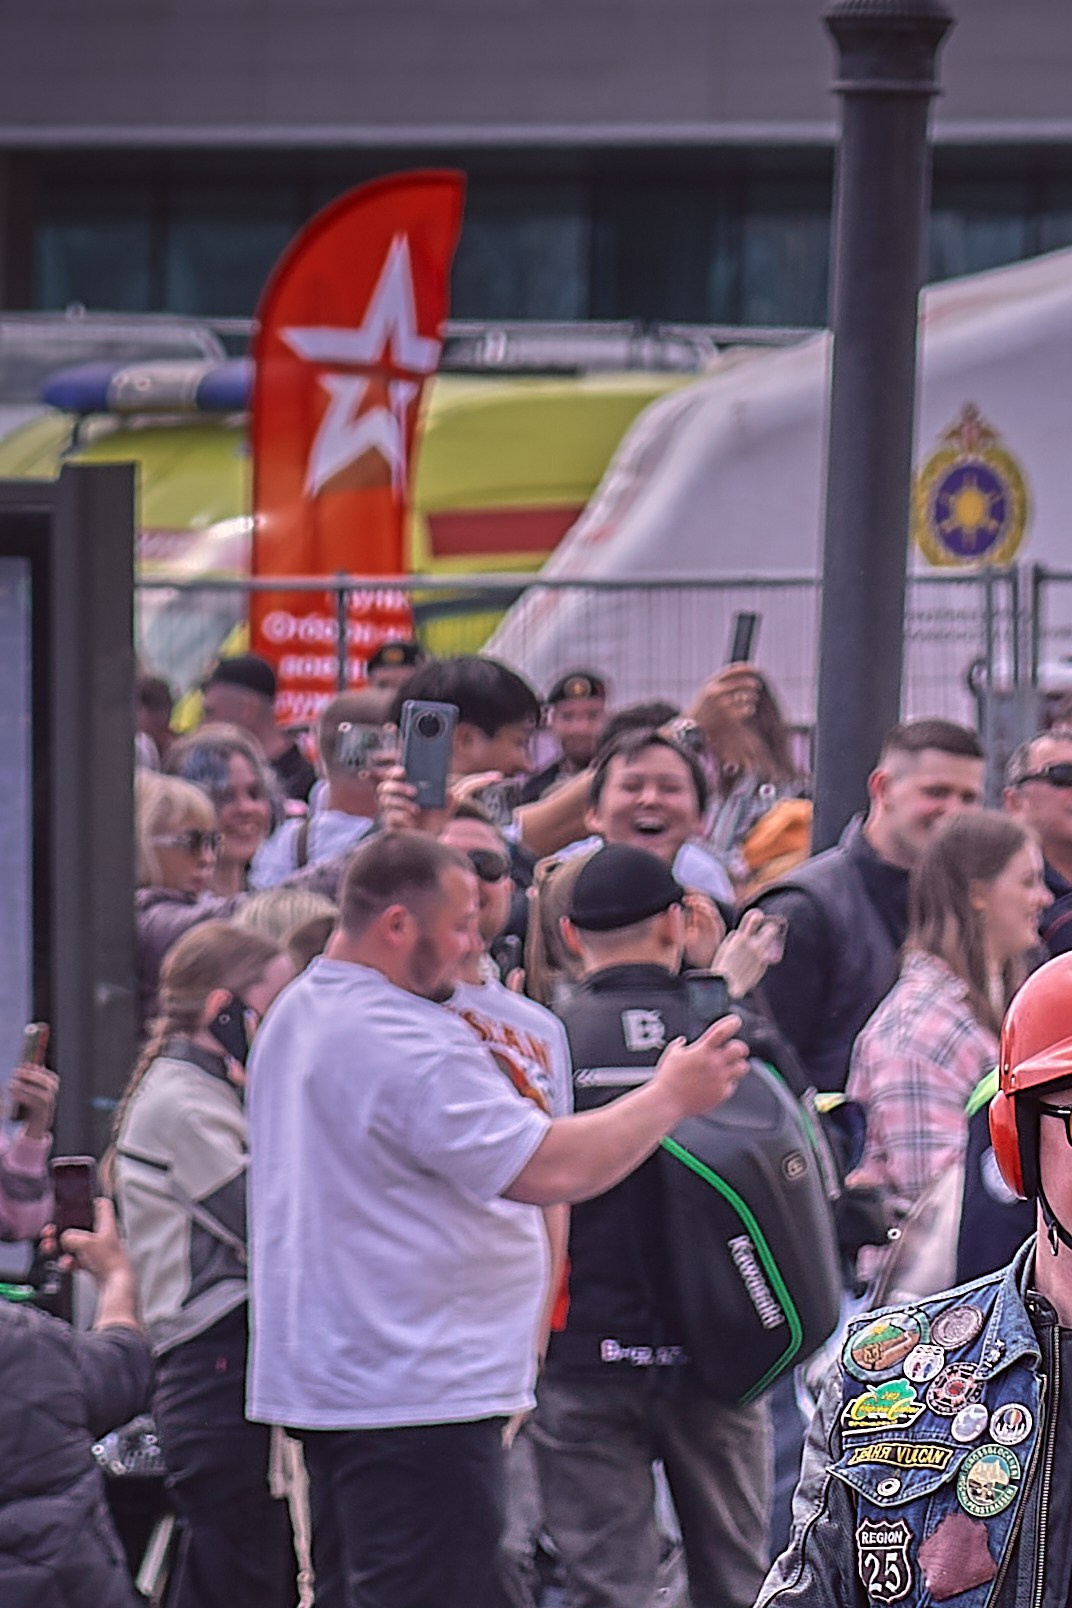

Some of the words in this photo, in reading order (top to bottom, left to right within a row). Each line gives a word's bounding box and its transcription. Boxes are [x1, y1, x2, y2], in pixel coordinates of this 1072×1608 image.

[728, 1234, 785, 1330] Kawasaki
[897, 1446, 945, 1464] VULCAN
[861, 1530, 903, 1545] REGION
[864, 1552, 901, 1594] 25
